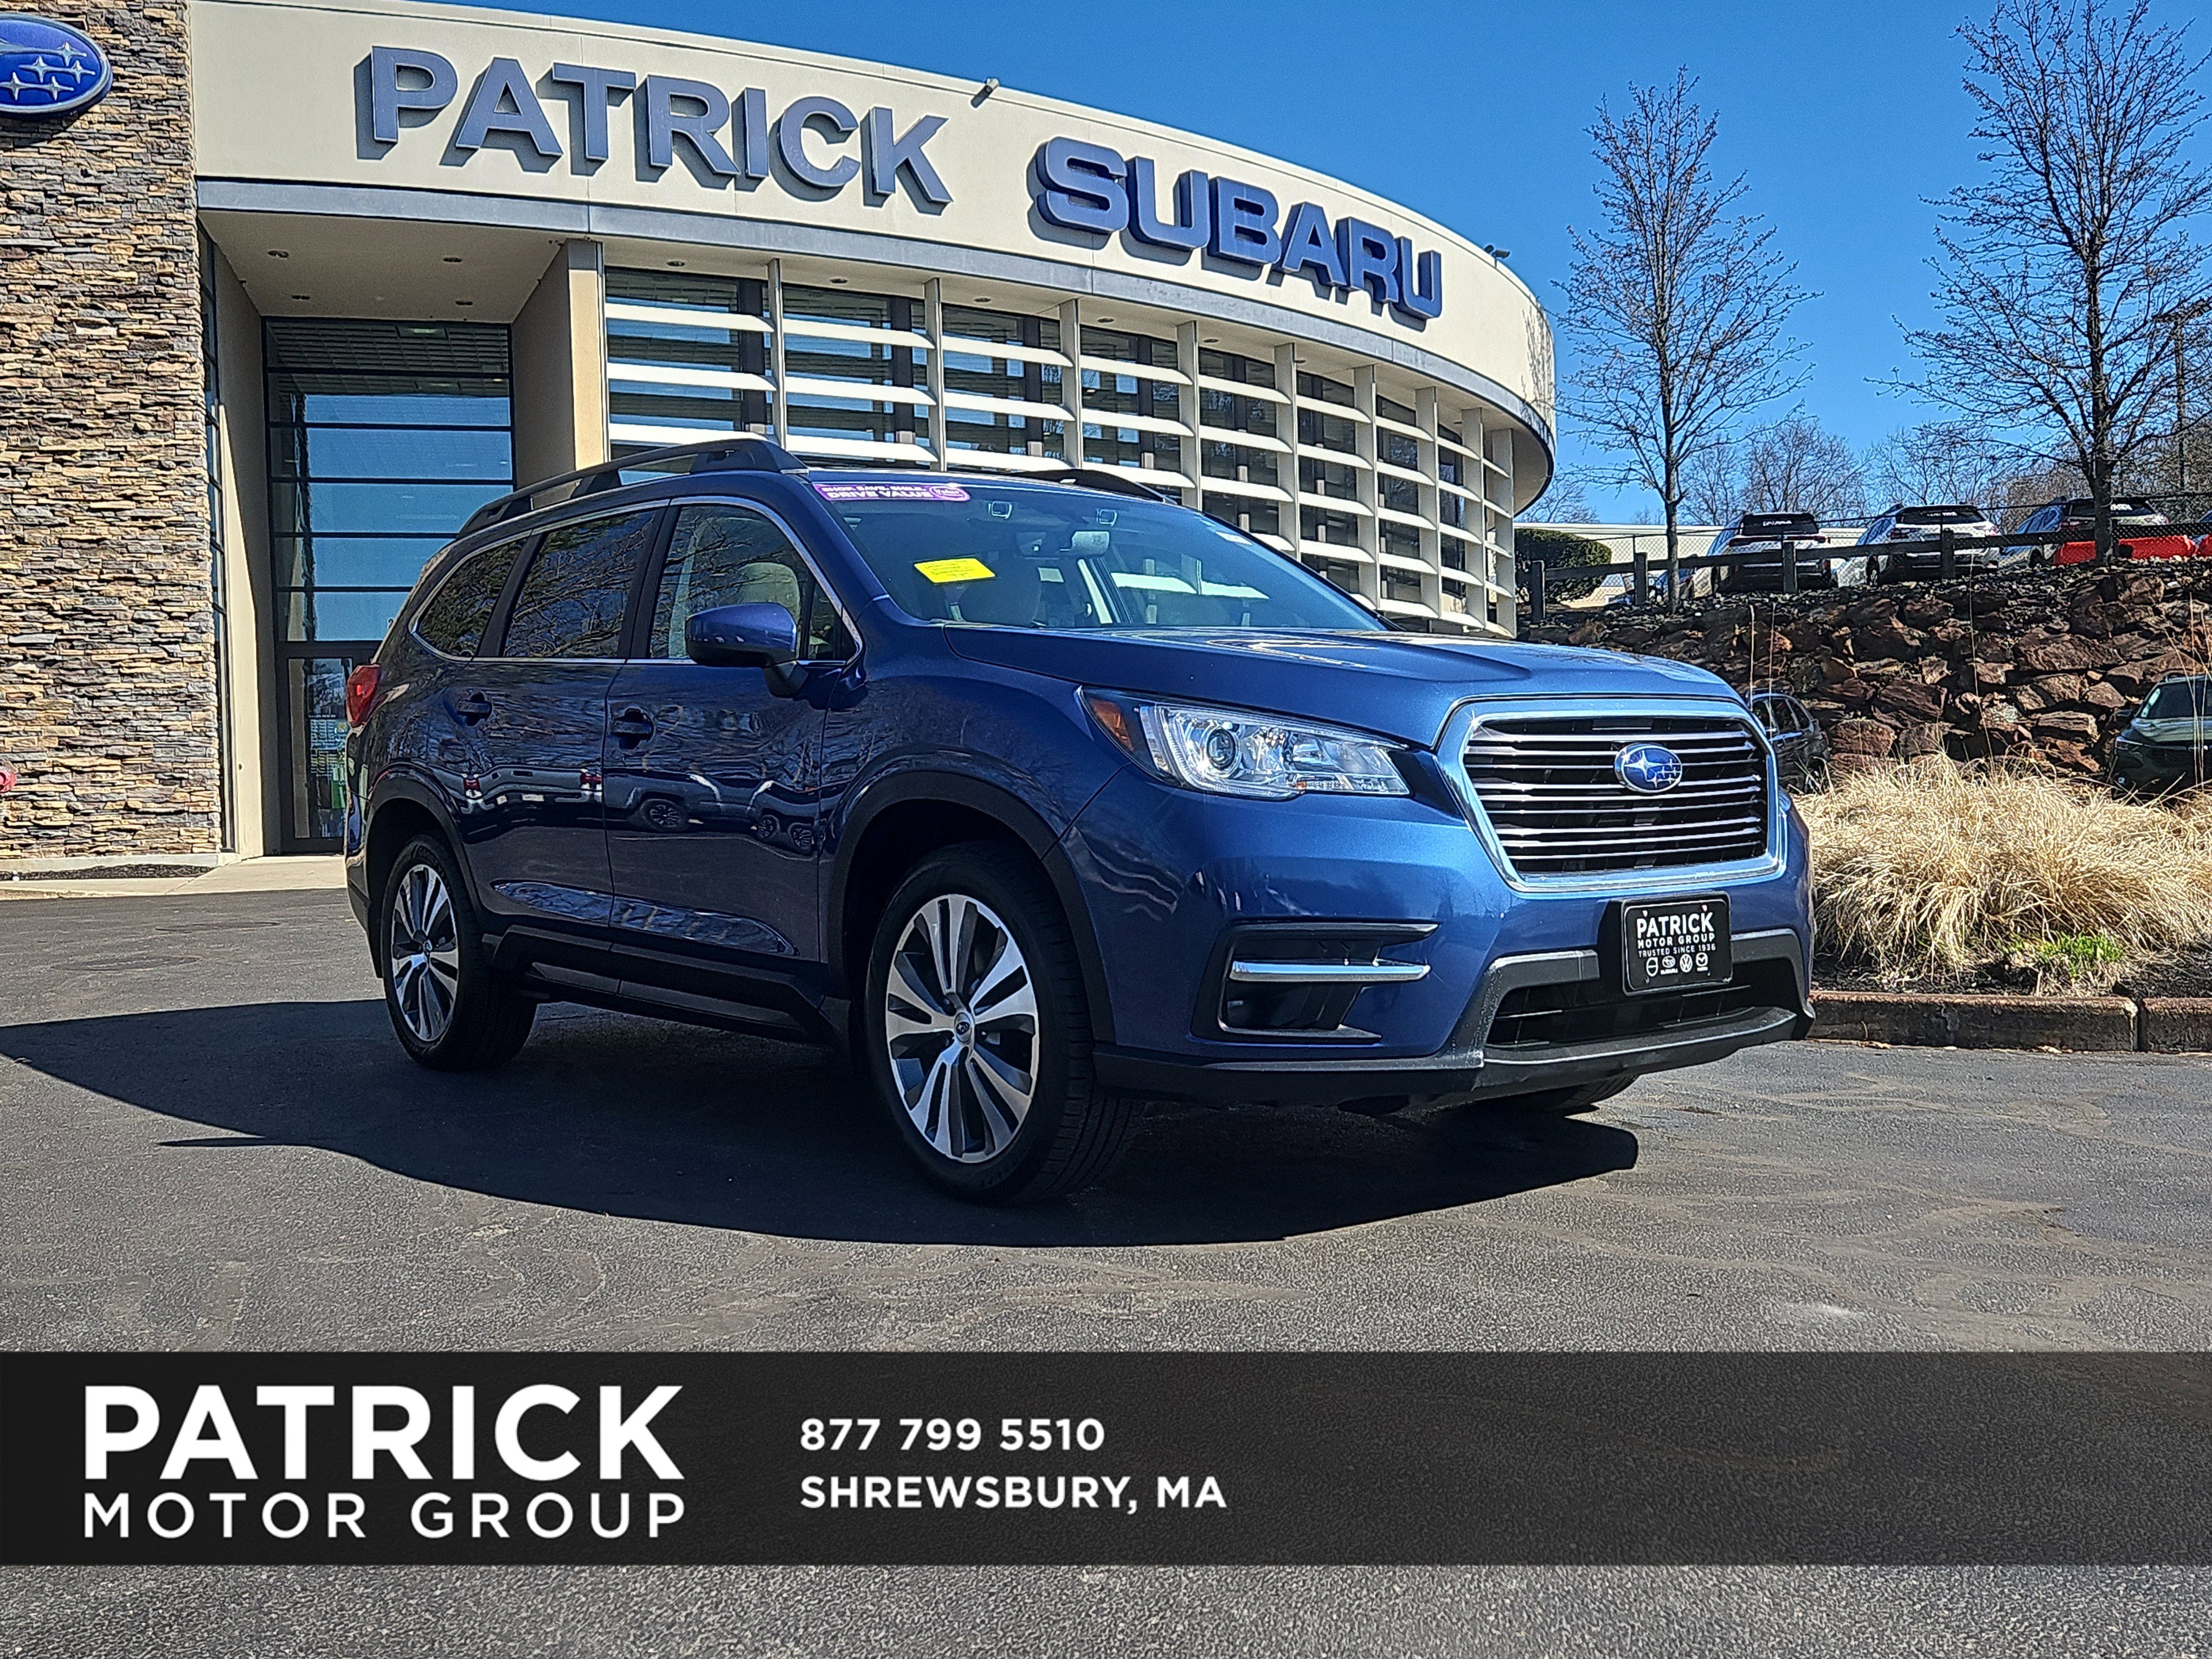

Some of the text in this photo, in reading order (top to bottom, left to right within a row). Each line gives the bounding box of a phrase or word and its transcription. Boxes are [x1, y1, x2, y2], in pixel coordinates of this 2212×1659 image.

[369, 44, 1444, 320] PATRICK SUBARU
[1636, 912, 1714, 939] PATRICK
[1637, 933, 1715, 949] MOTOR GROUP
[1638, 948, 1670, 958] TRUSTED
[1673, 945, 1695, 954] SINCE
